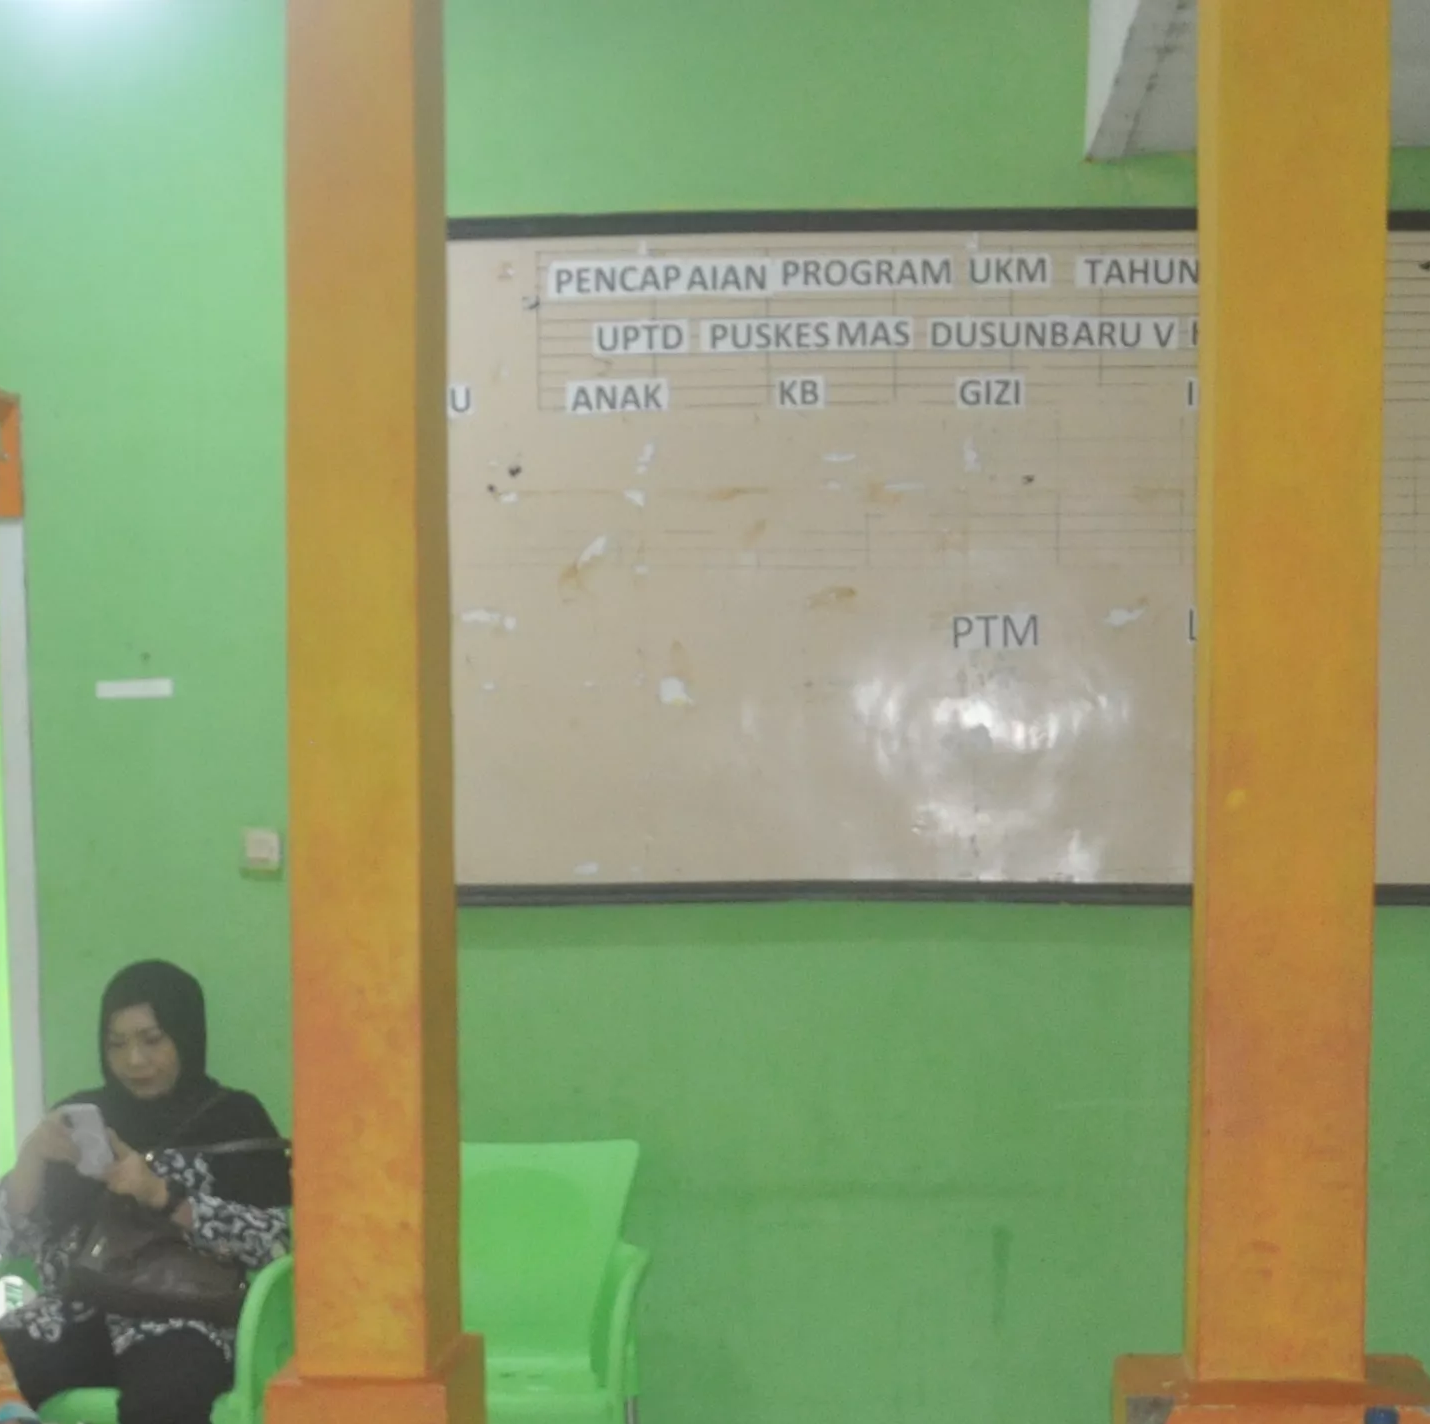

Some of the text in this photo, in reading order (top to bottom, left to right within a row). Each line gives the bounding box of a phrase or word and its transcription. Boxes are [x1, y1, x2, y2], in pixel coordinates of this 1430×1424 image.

[555, 256, 1200, 295] PENCAPAIAN PROGRAM UKM TAHUN
[596, 323, 684, 352] UPTD
[709, 319, 911, 350] PUSKESMAS
[930, 320, 1142, 349] DUSUNBARU
[570, 383, 663, 412] ANAK
[778, 379, 820, 406] KB
[958, 379, 1021, 406] GIZI
[952, 613, 1039, 649] PTM
